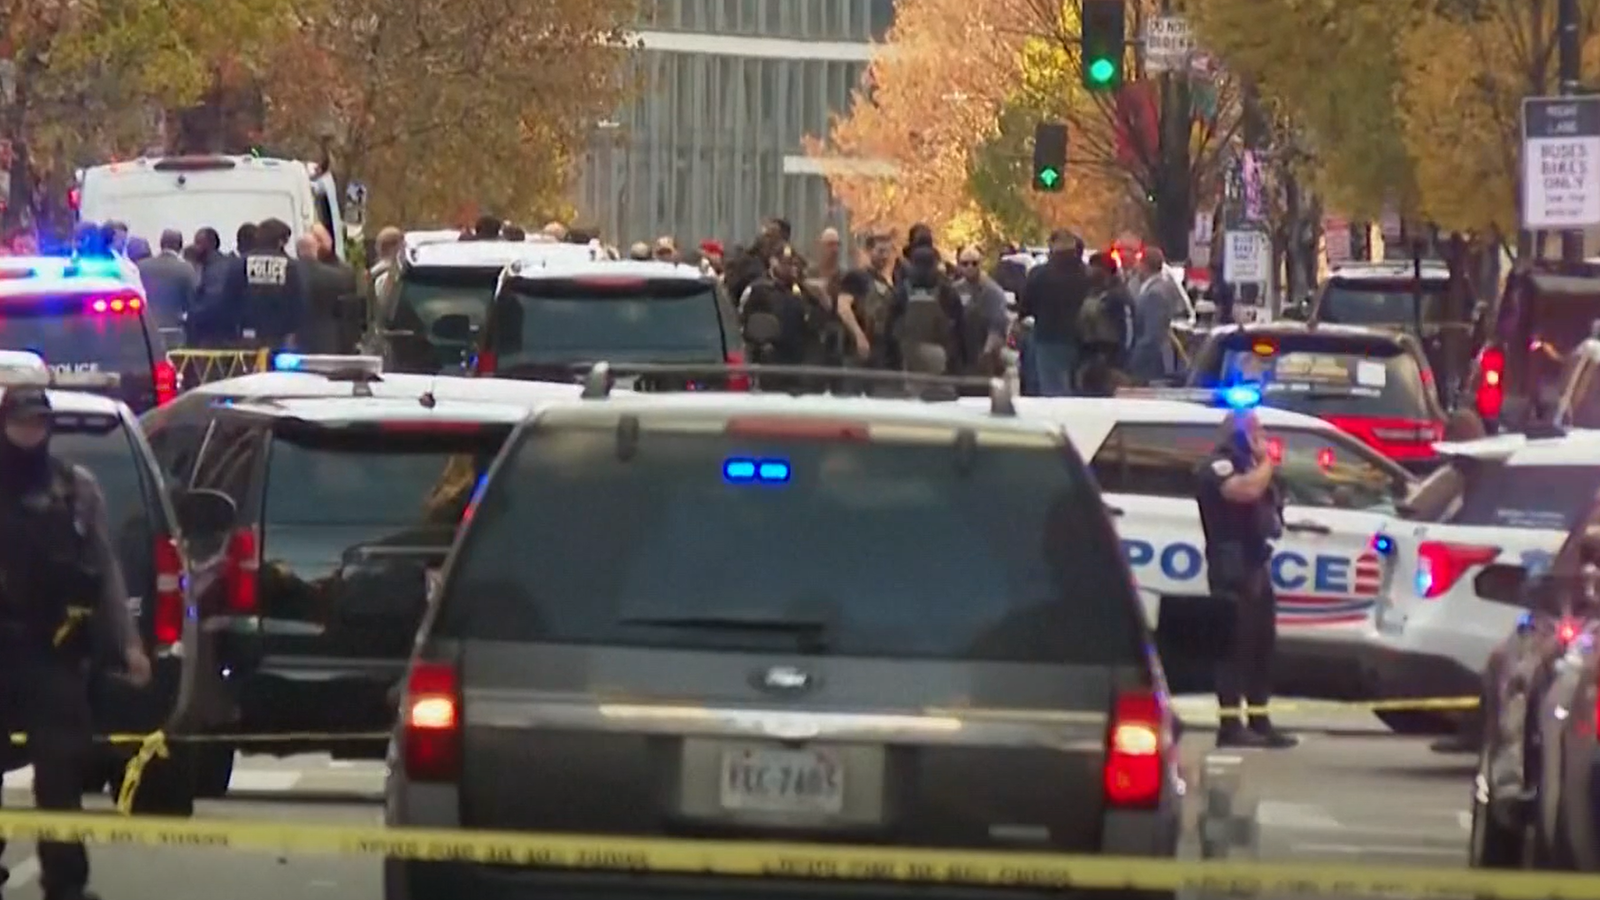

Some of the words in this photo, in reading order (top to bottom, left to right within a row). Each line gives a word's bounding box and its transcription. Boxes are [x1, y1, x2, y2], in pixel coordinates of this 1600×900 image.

[1541, 144, 1587, 157] BUSES
[1541, 161, 1587, 174] BIKES
[1543, 177, 1584, 189] ONLY
[247, 258, 286, 280] POLICE
[1120, 538, 1350, 593] POCE
